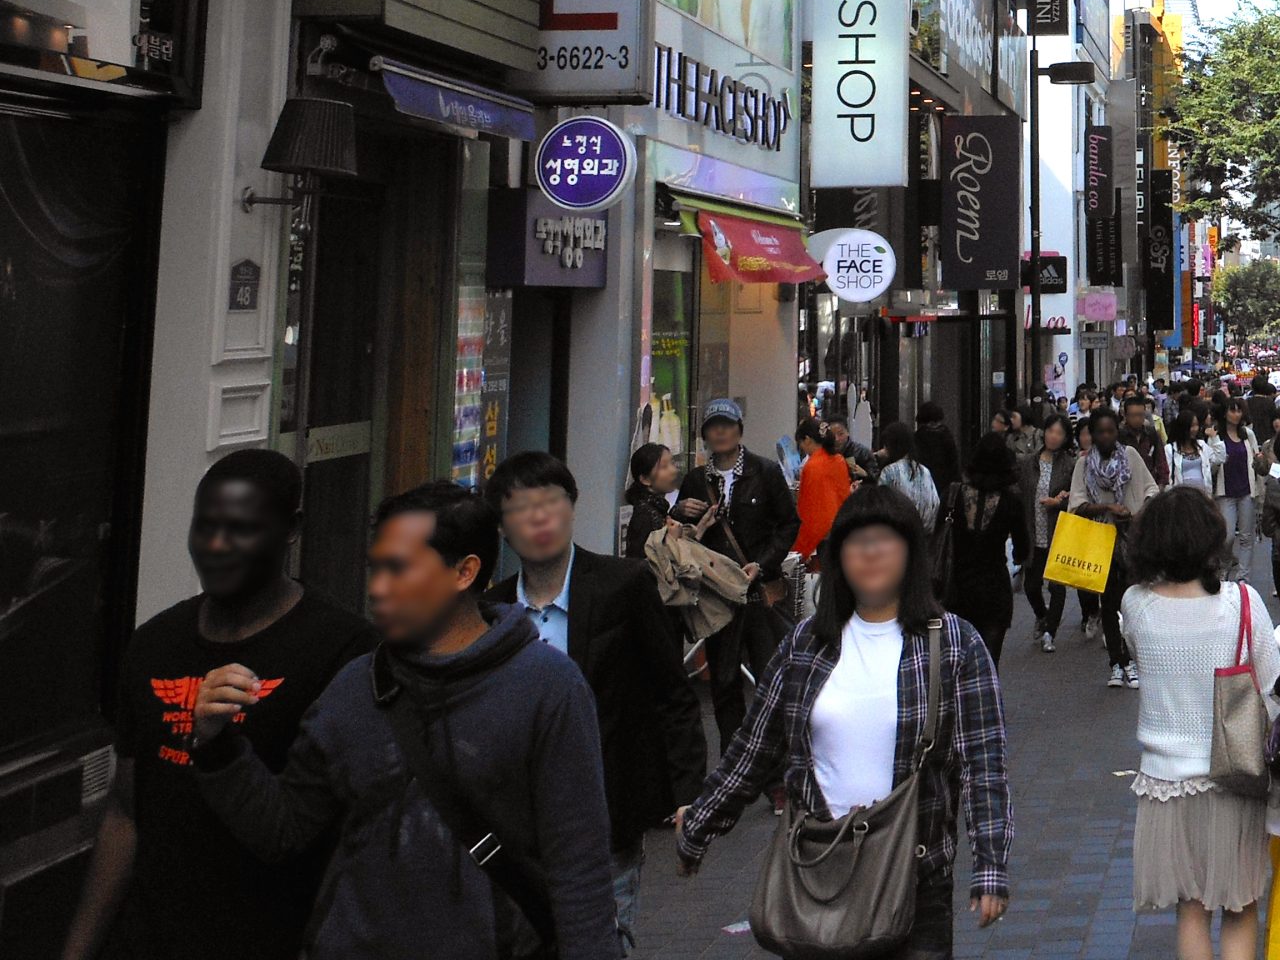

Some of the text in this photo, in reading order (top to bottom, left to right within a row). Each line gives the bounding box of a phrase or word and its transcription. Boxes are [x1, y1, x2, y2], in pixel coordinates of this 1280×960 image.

[561, 135, 602, 154] 노정식
[1088, 133, 1107, 188] banila
[545, 158, 620, 186] 성형외과
[953, 131, 993, 264] Roem
[837, 243, 872, 258] THE
[836, 259, 883, 274] FACE
[836, 275, 883, 289] SHOP
[236, 287, 251, 307] 48
[1055, 553, 1102, 574] FOREVER 21
